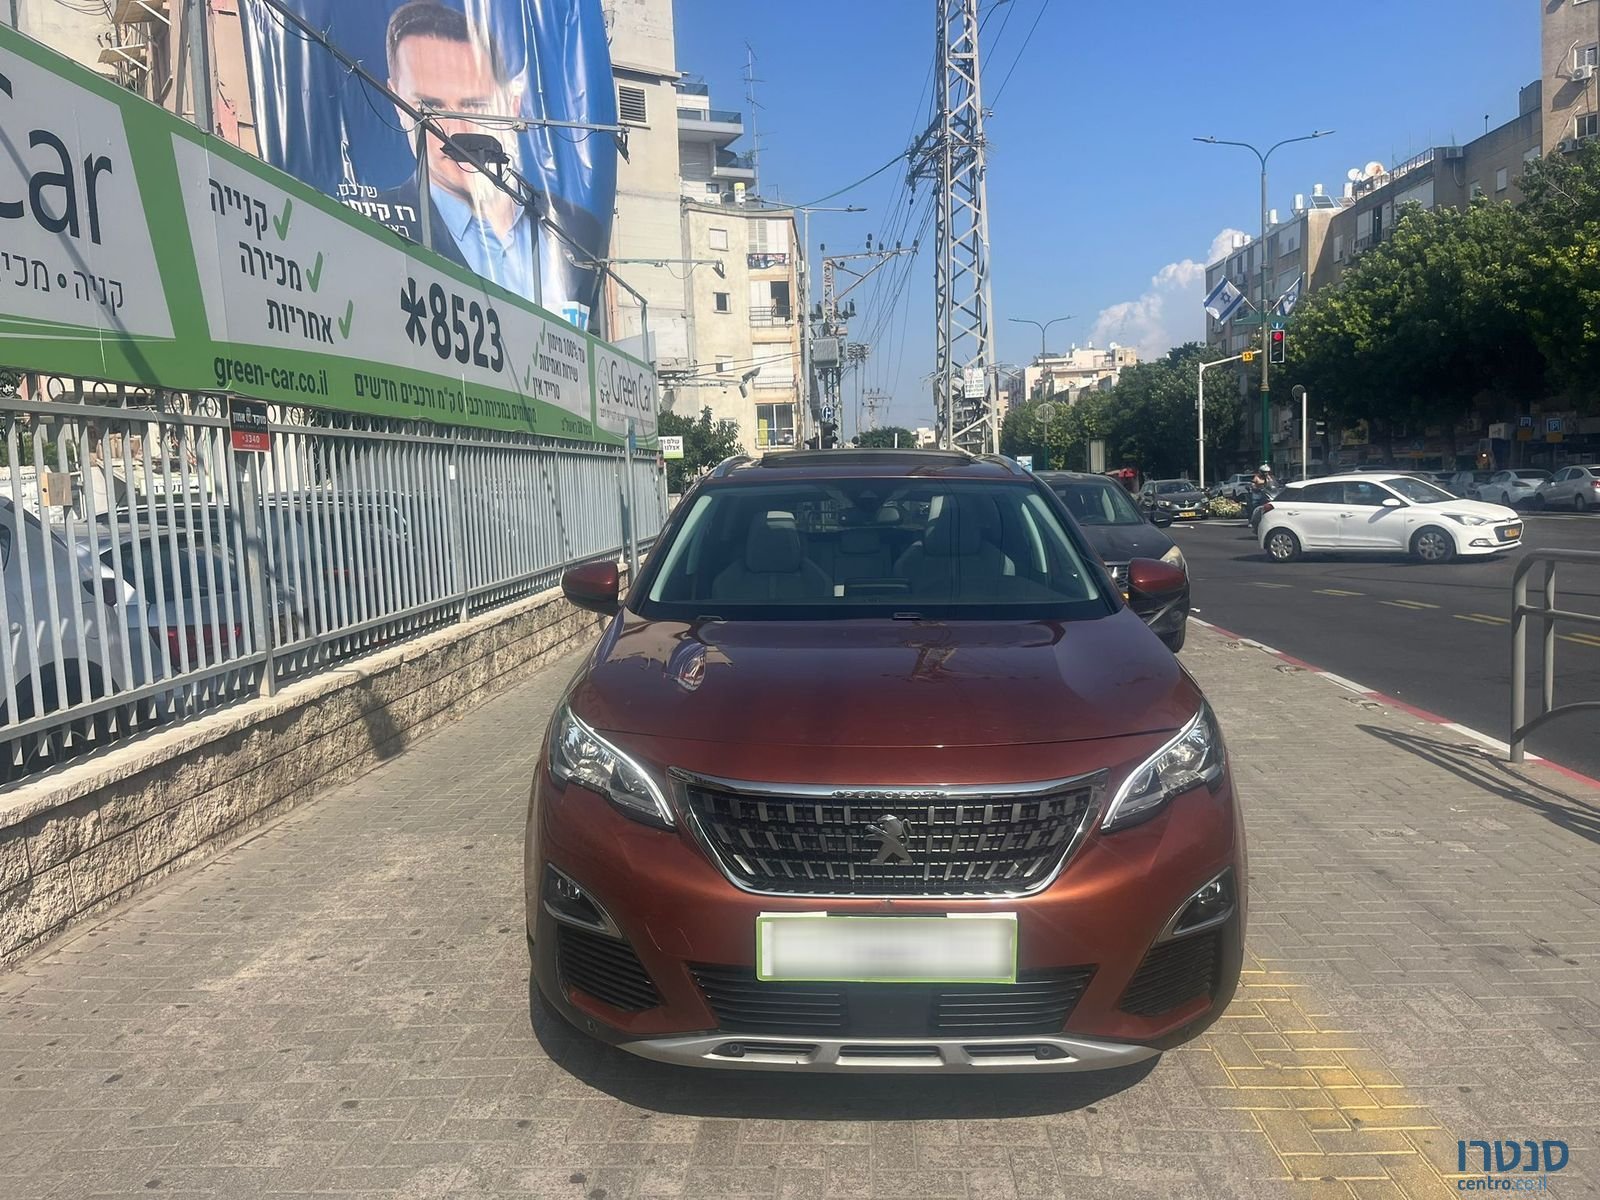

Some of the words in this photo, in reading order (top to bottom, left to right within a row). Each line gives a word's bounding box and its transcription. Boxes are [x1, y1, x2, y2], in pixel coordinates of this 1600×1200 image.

[209, 178, 268, 240] קנייה
[336, 184, 377, 198] שלכם,
[394, 204, 416, 222] רז
[0, 252, 50, 293] מכי
[239, 241, 302, 291] מכירה
[73, 269, 124, 317] קניה
[266, 299, 334, 344] אחריות
[213, 356, 329, 396] green-car.co.il
[354, 373, 398, 402] חדשים
[400, 382, 436, 410] ורכבים
[610, 360, 639, 409] Green
[639, 372, 651, 412] Car
